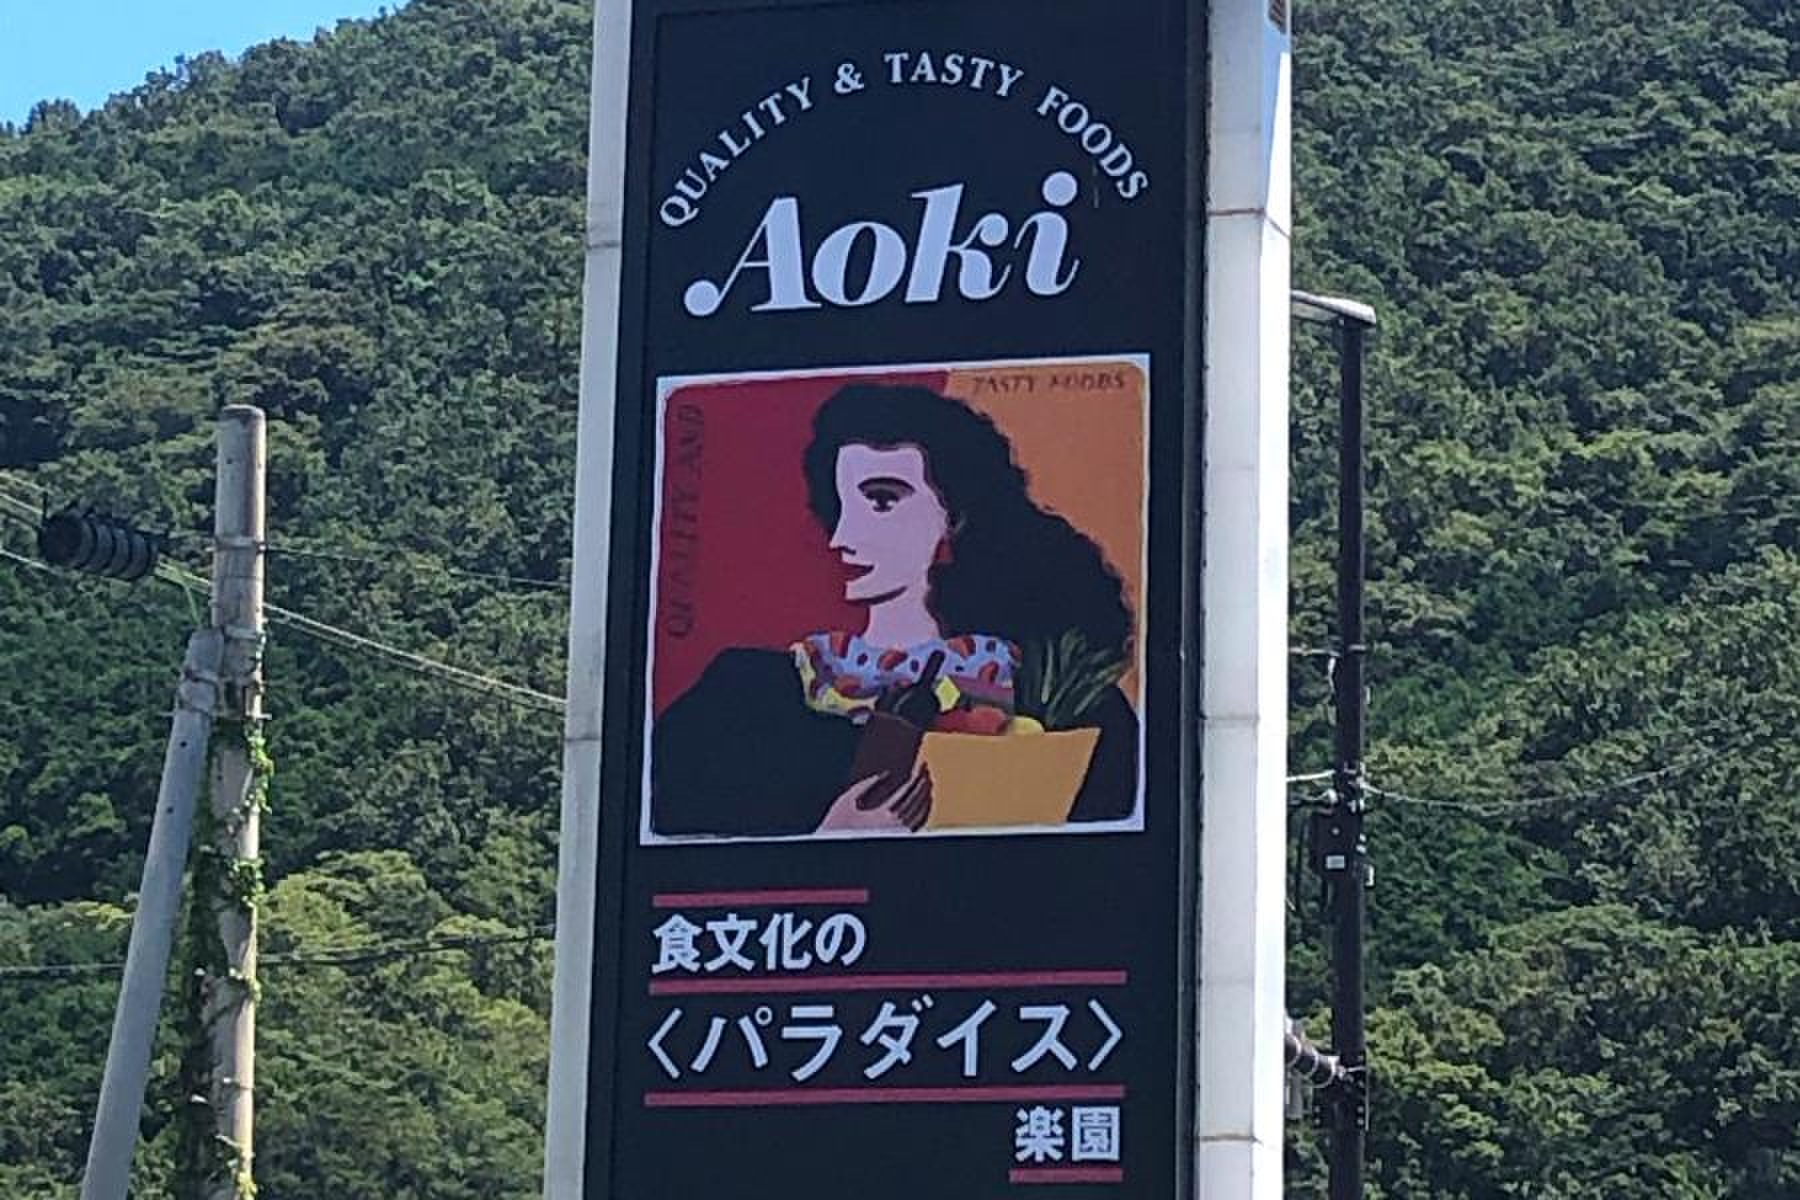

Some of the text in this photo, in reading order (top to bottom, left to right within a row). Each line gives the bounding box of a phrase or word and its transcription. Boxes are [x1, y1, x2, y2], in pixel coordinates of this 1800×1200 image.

[659, 52, 1149, 227] QUALITY & TASTY FOODS
[684, 171, 1080, 317] Aoki
[651, 912, 866, 974] 食文化の
[1015, 1106, 1121, 1162] 楽園
